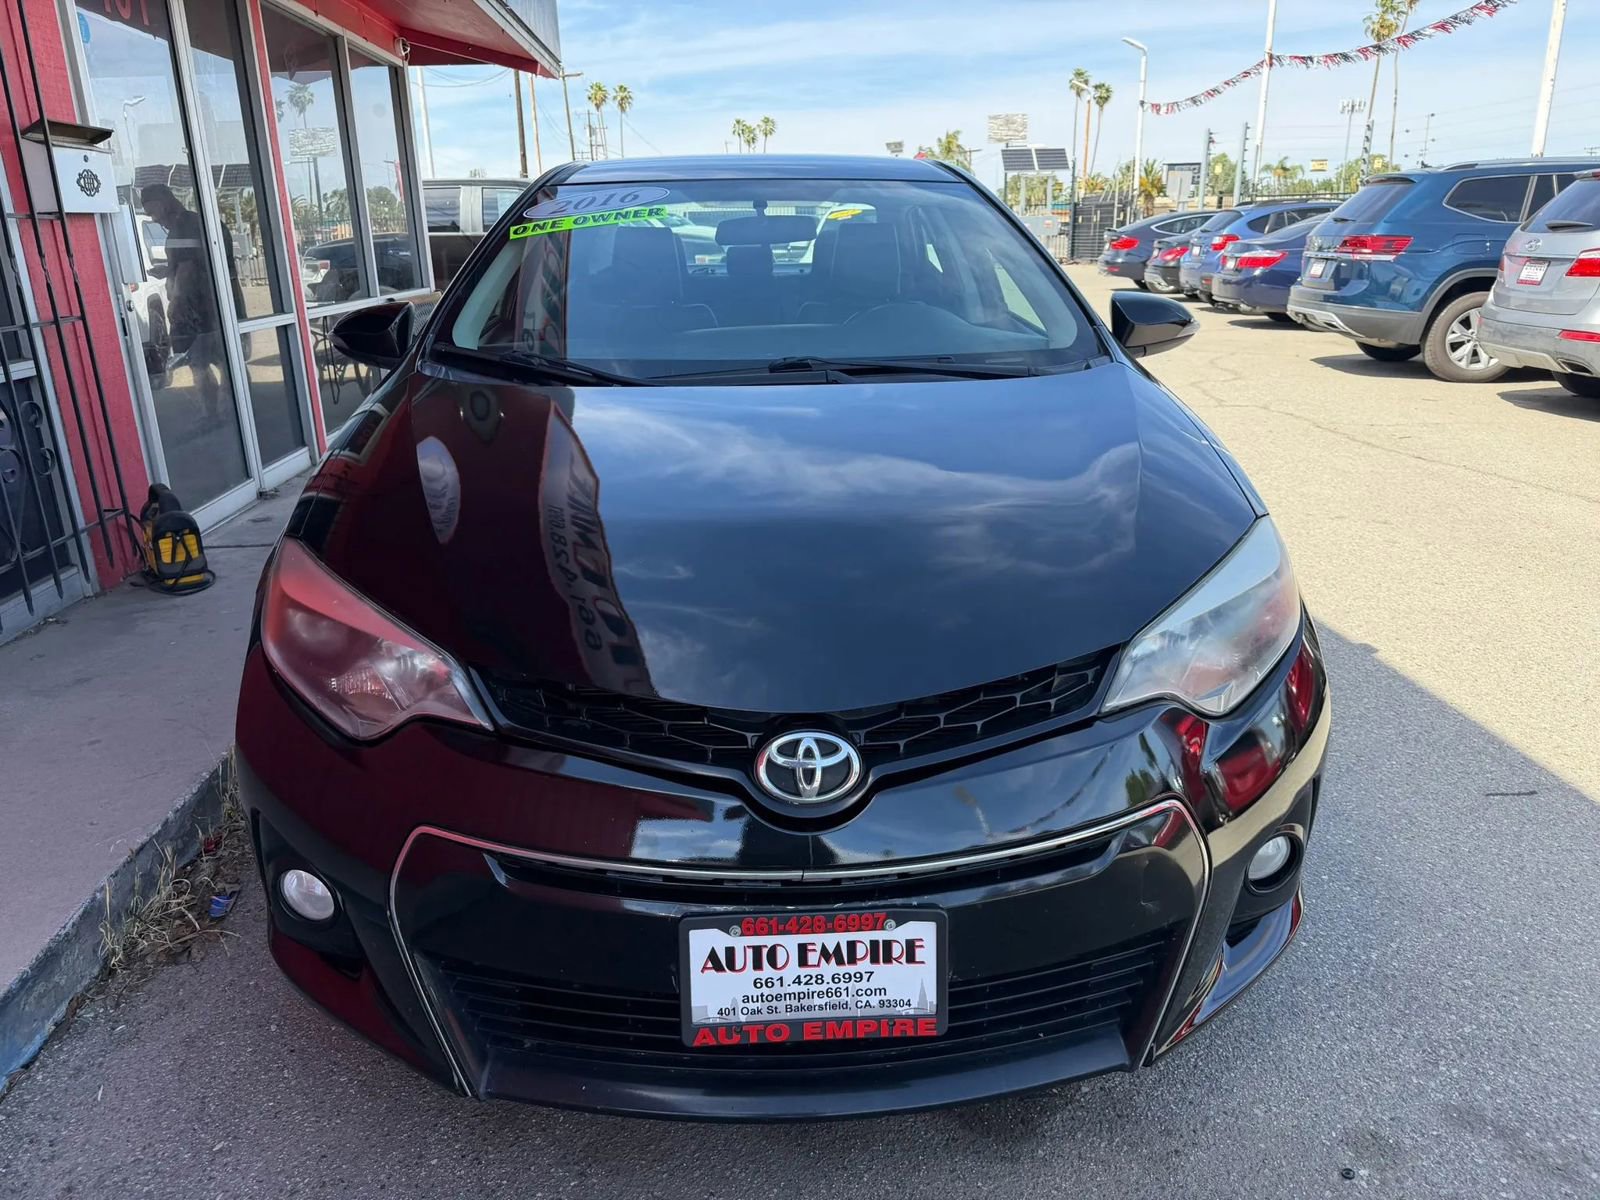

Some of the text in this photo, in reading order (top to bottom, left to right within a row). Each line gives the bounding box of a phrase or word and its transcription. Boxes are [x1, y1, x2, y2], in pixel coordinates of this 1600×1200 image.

[550, 190, 640, 215] 2016
[512, 207, 665, 236] ONE OWNER
[740, 912, 887, 937] 661-428-6997
[700, 938, 926, 975] AUTO EMPIRE
[752, 971, 875, 989] 661.428.6997
[717, 998, 912, 1017] 401 Oak St. Bakersfield, CA. 93304
[741, 985, 887, 1005] autoempire661.com
[692, 1017, 938, 1047] AUTO EMPIRE
